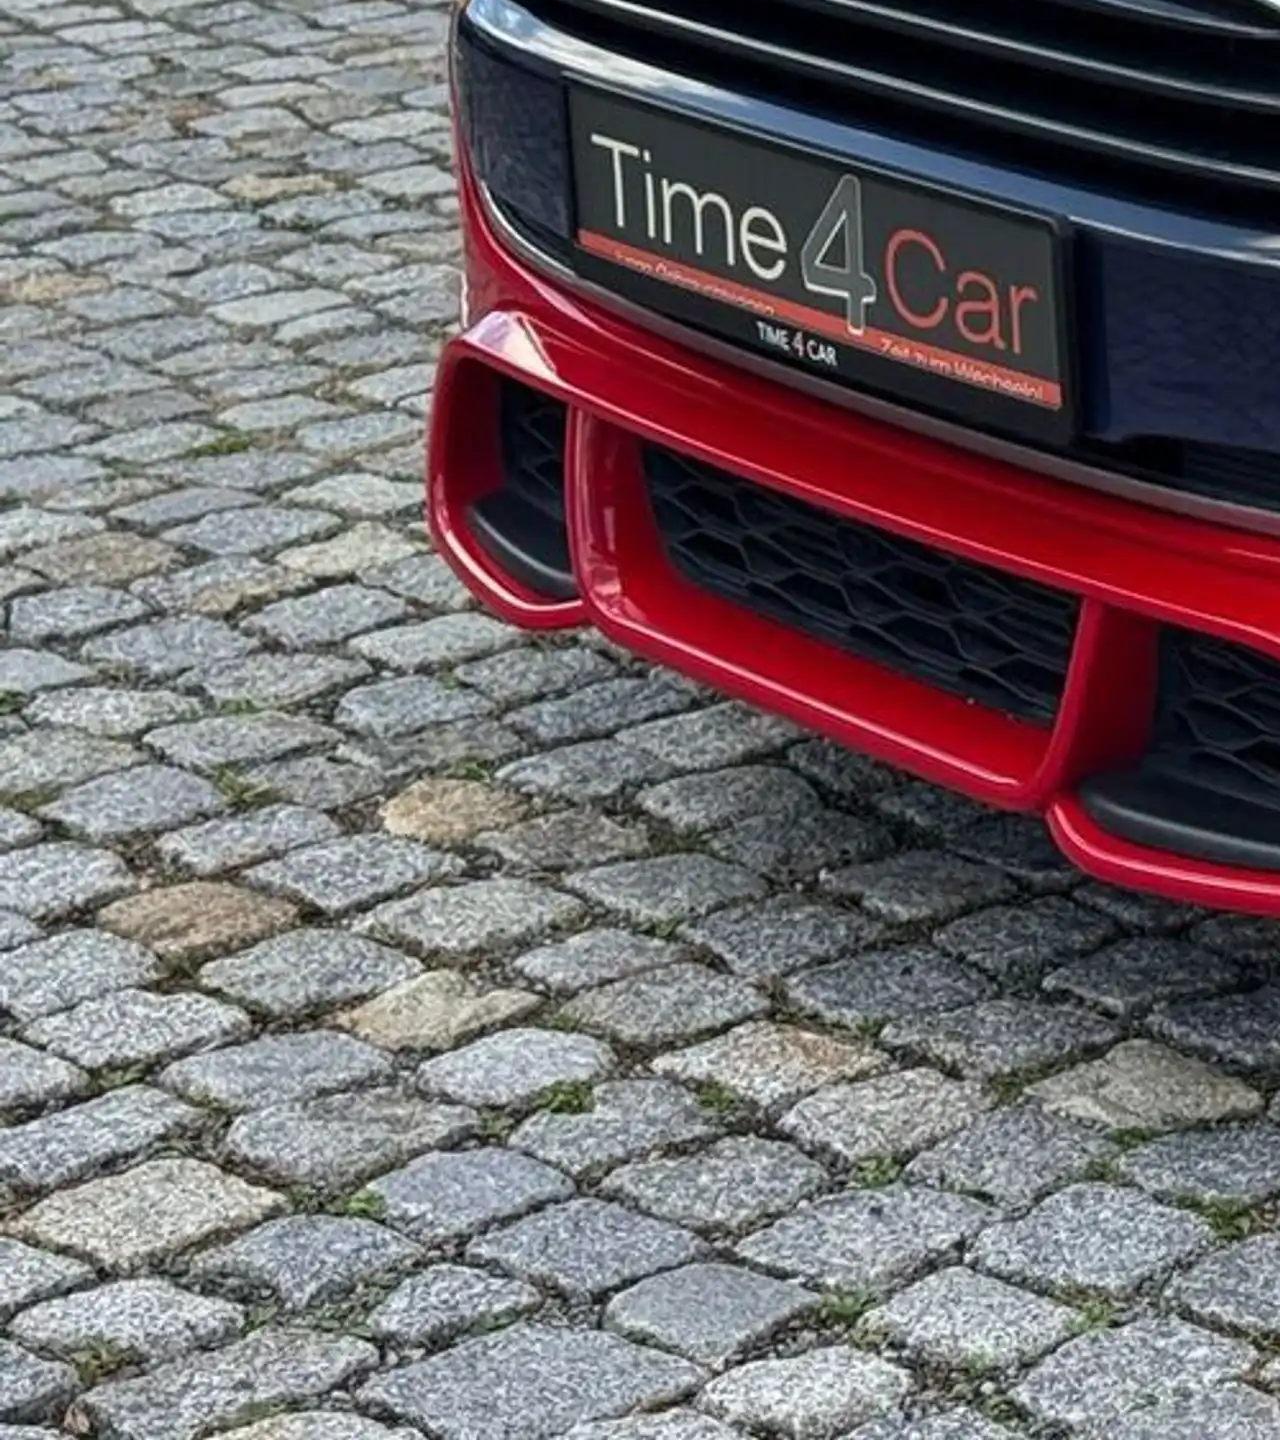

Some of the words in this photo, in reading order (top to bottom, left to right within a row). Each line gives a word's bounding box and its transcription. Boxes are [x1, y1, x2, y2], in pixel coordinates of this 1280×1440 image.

[755, 320, 790, 352] TIME
[791, 331, 804, 358] 4
[806, 339, 838, 367] CAR
